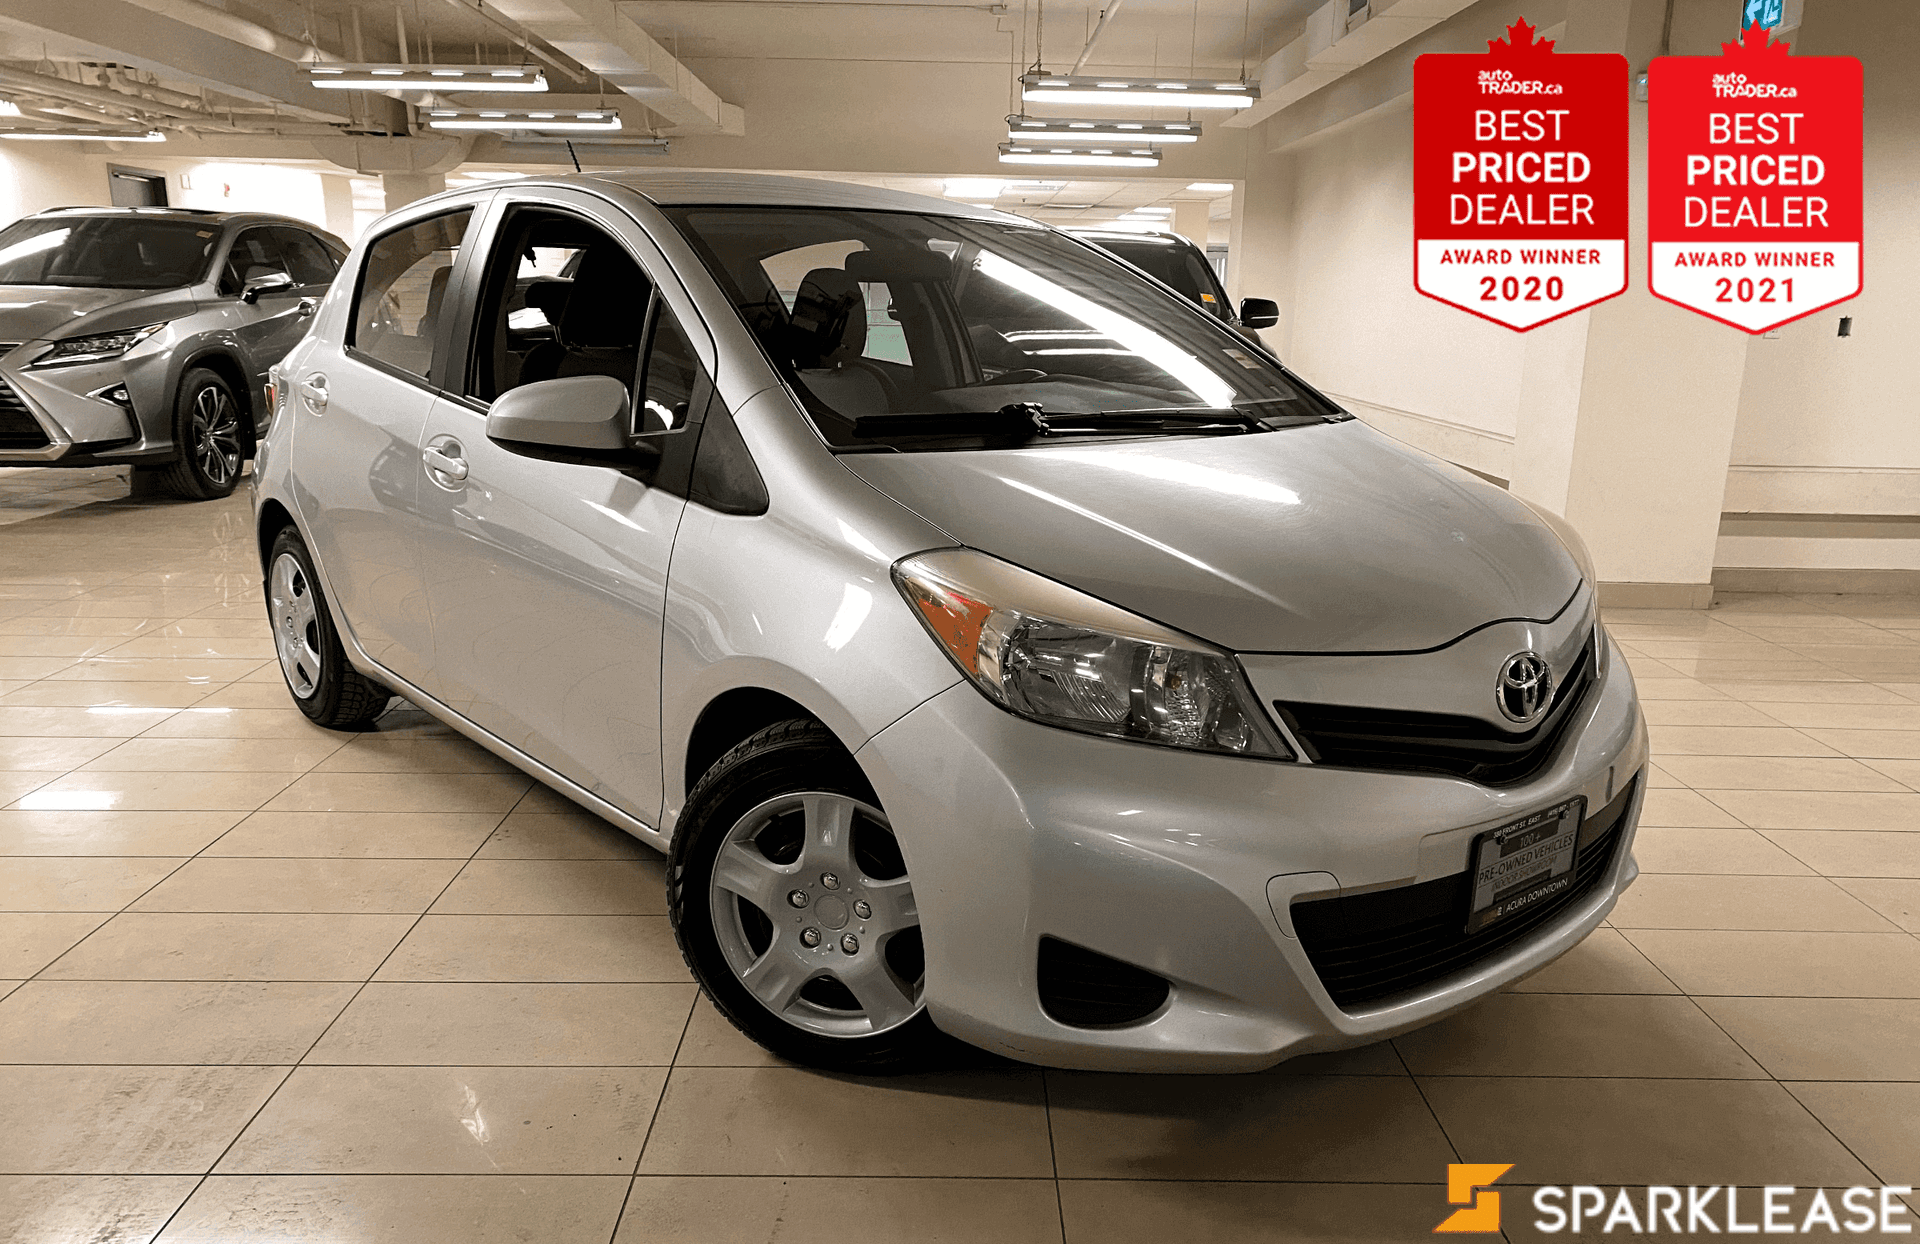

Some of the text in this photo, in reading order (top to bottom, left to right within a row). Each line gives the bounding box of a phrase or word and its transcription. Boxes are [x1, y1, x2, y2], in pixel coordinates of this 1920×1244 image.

[1502, 823, 1519, 835] FRONT
[1528, 814, 1541, 826] EAST
[1479, 833, 1574, 884] PRE-OWNED VEHICLES
[1518, 855, 1557, 878] SHOWROOM
[1506, 877, 1568, 913] ACURA DOWNTOWN
